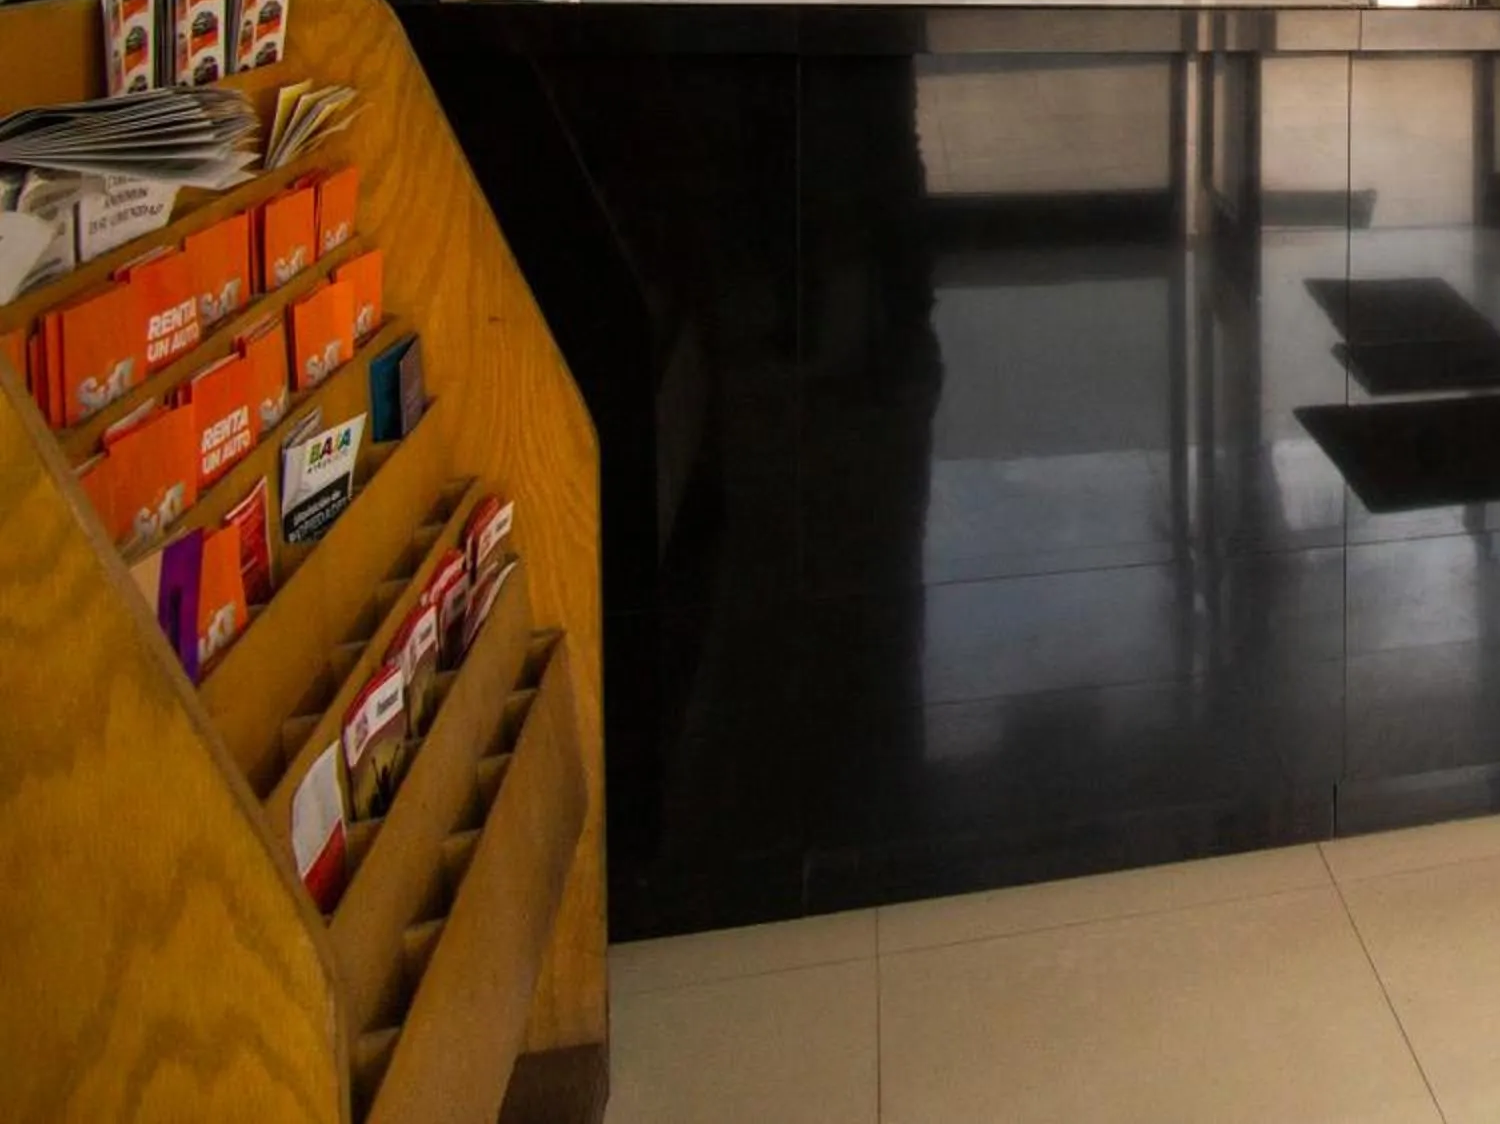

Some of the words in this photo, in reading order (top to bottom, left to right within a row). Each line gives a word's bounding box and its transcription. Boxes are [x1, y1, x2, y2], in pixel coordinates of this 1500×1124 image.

[147, 296, 197, 339] RENTA
[147, 340, 170, 363] UN
[170, 323, 200, 354] AUTO
[201, 406, 249, 453] RENTA
[202, 451, 221, 475] UN
[221, 431, 251, 465] AUTO
